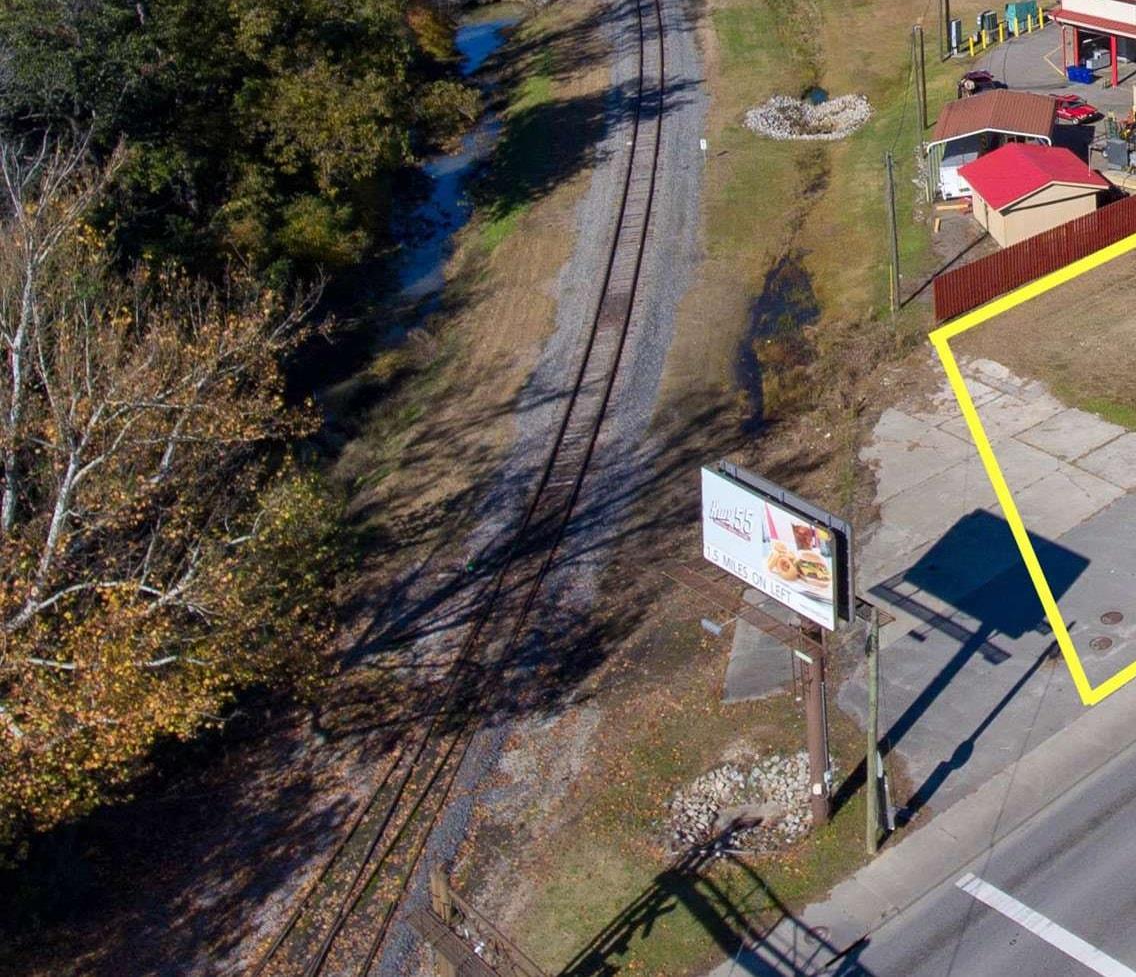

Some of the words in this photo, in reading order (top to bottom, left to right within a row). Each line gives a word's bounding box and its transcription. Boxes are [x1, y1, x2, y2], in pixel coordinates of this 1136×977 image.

[733, 507, 753, 534] 55
[722, 554, 748, 579] MILES
[752, 571, 767, 591] ON
[771, 582, 791, 604] LEFT
